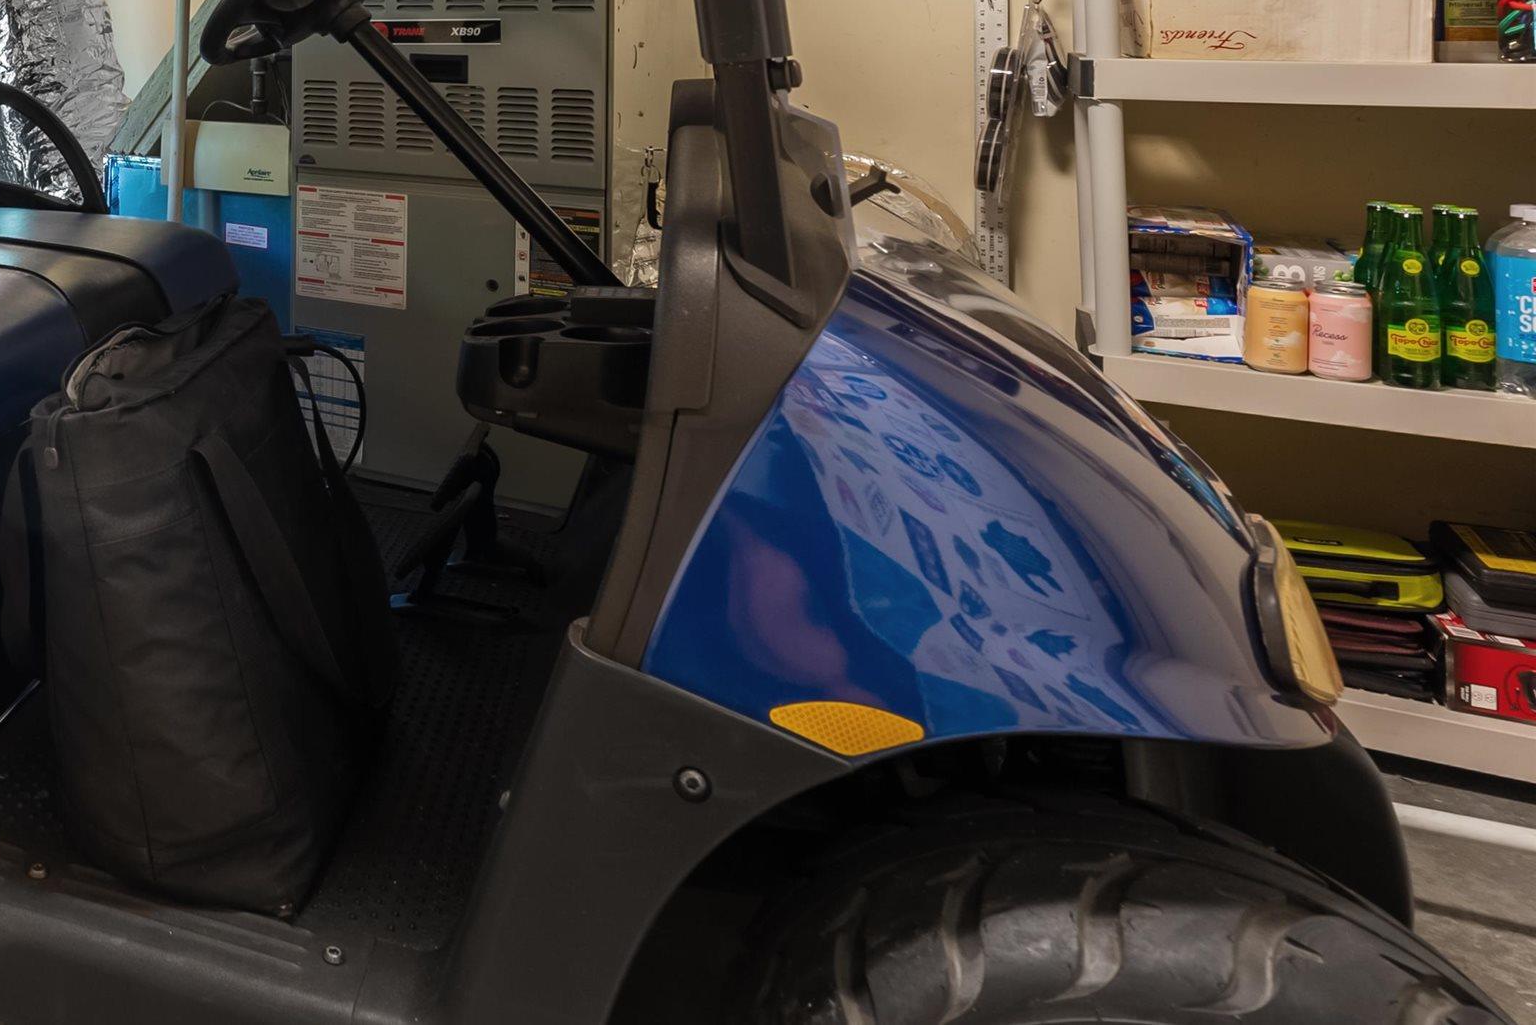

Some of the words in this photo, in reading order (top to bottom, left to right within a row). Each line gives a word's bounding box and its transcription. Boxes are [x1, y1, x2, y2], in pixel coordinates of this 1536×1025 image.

[393, 27, 426, 36] TRANE
[450, 27, 481, 36] XB90
[1312, 324, 1349, 341] Recess
